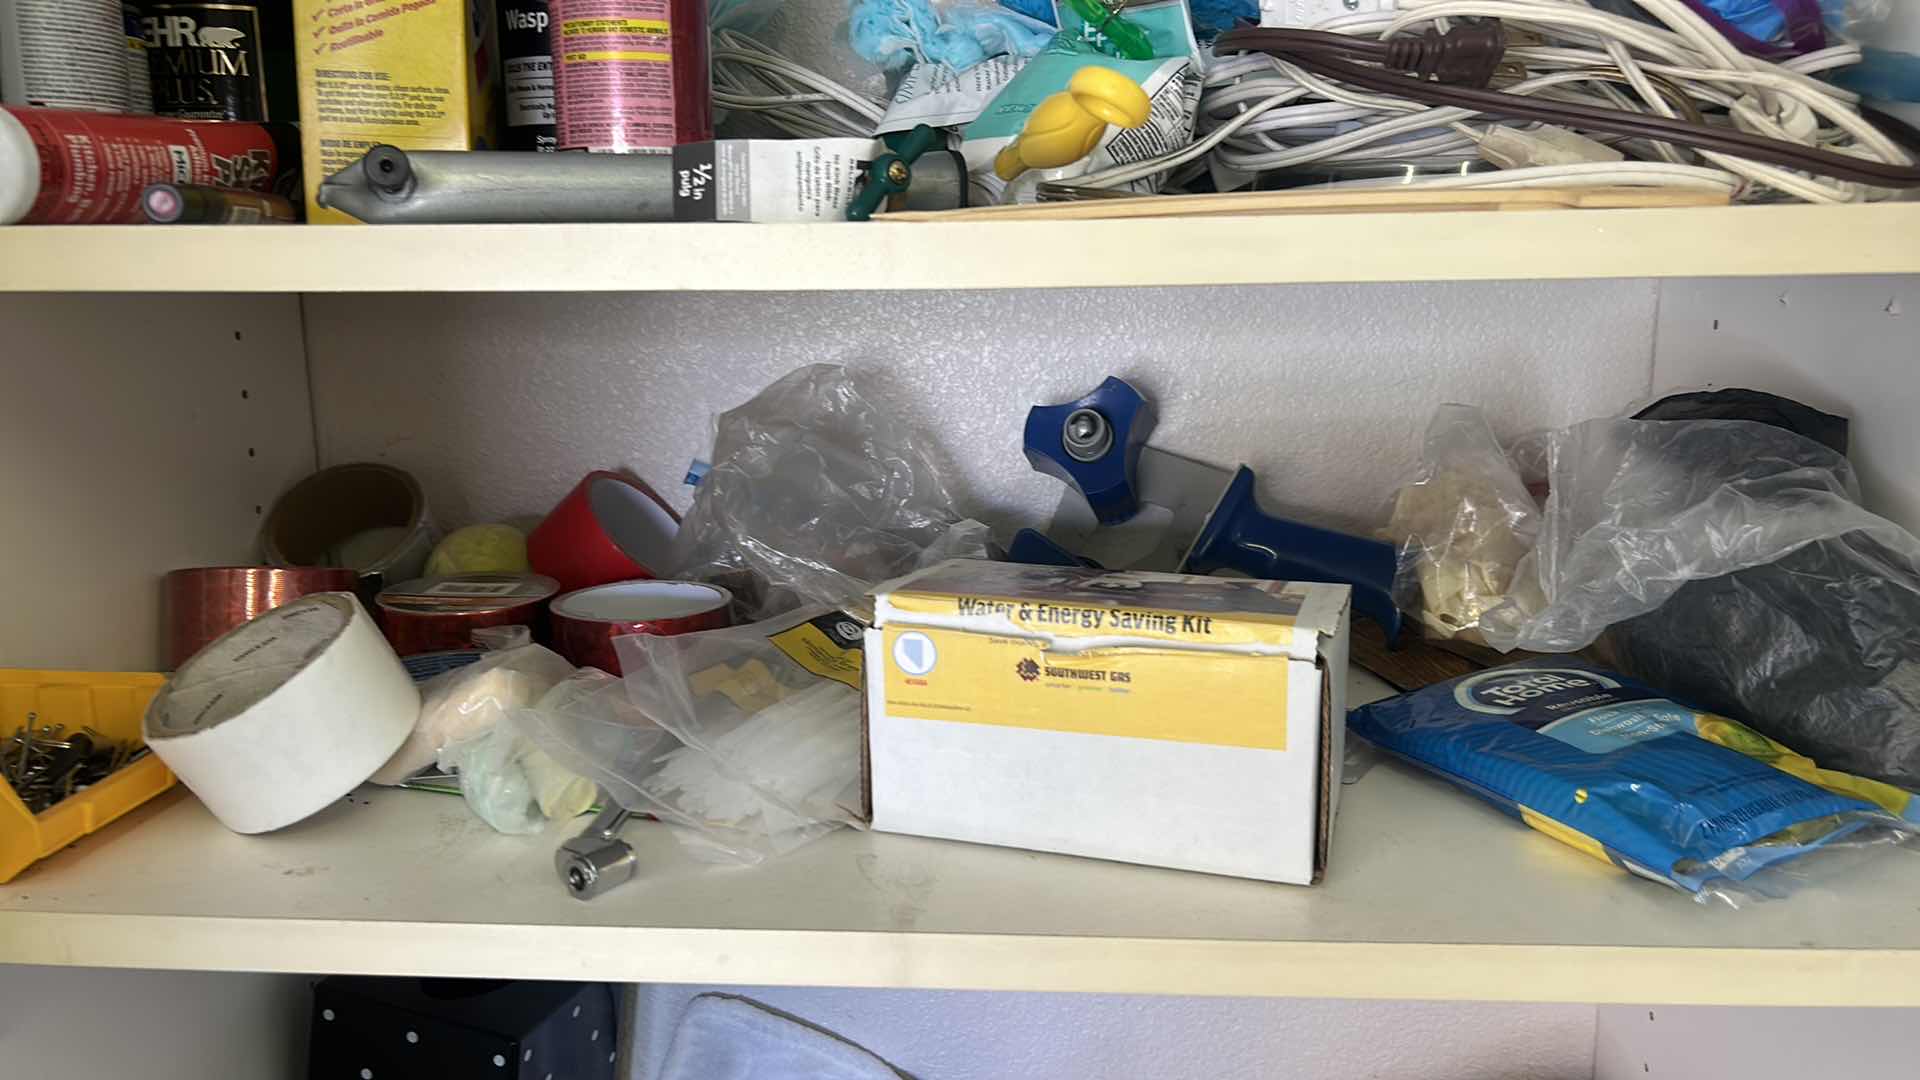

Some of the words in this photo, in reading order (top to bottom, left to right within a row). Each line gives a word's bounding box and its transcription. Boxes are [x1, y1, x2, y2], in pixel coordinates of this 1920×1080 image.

[507, 9, 549, 33] Wasp
[678, 169, 693, 197] pulg
[692, 163, 713, 187] 1/2
[692, 188, 706, 200] in
[957, 597, 1013, 618] Water
[1019, 604, 1033, 622] &
[1037, 603, 1104, 629] Energy
[1110, 608, 1176, 634] Saving
[1182, 614, 1213, 635] Kit
[1044, 666, 1107, 681] SOUTHWEST
[1110, 670, 1132, 684] GAS
[1479, 673, 1568, 698] Total
[1493, 677, 1592, 706] Home
